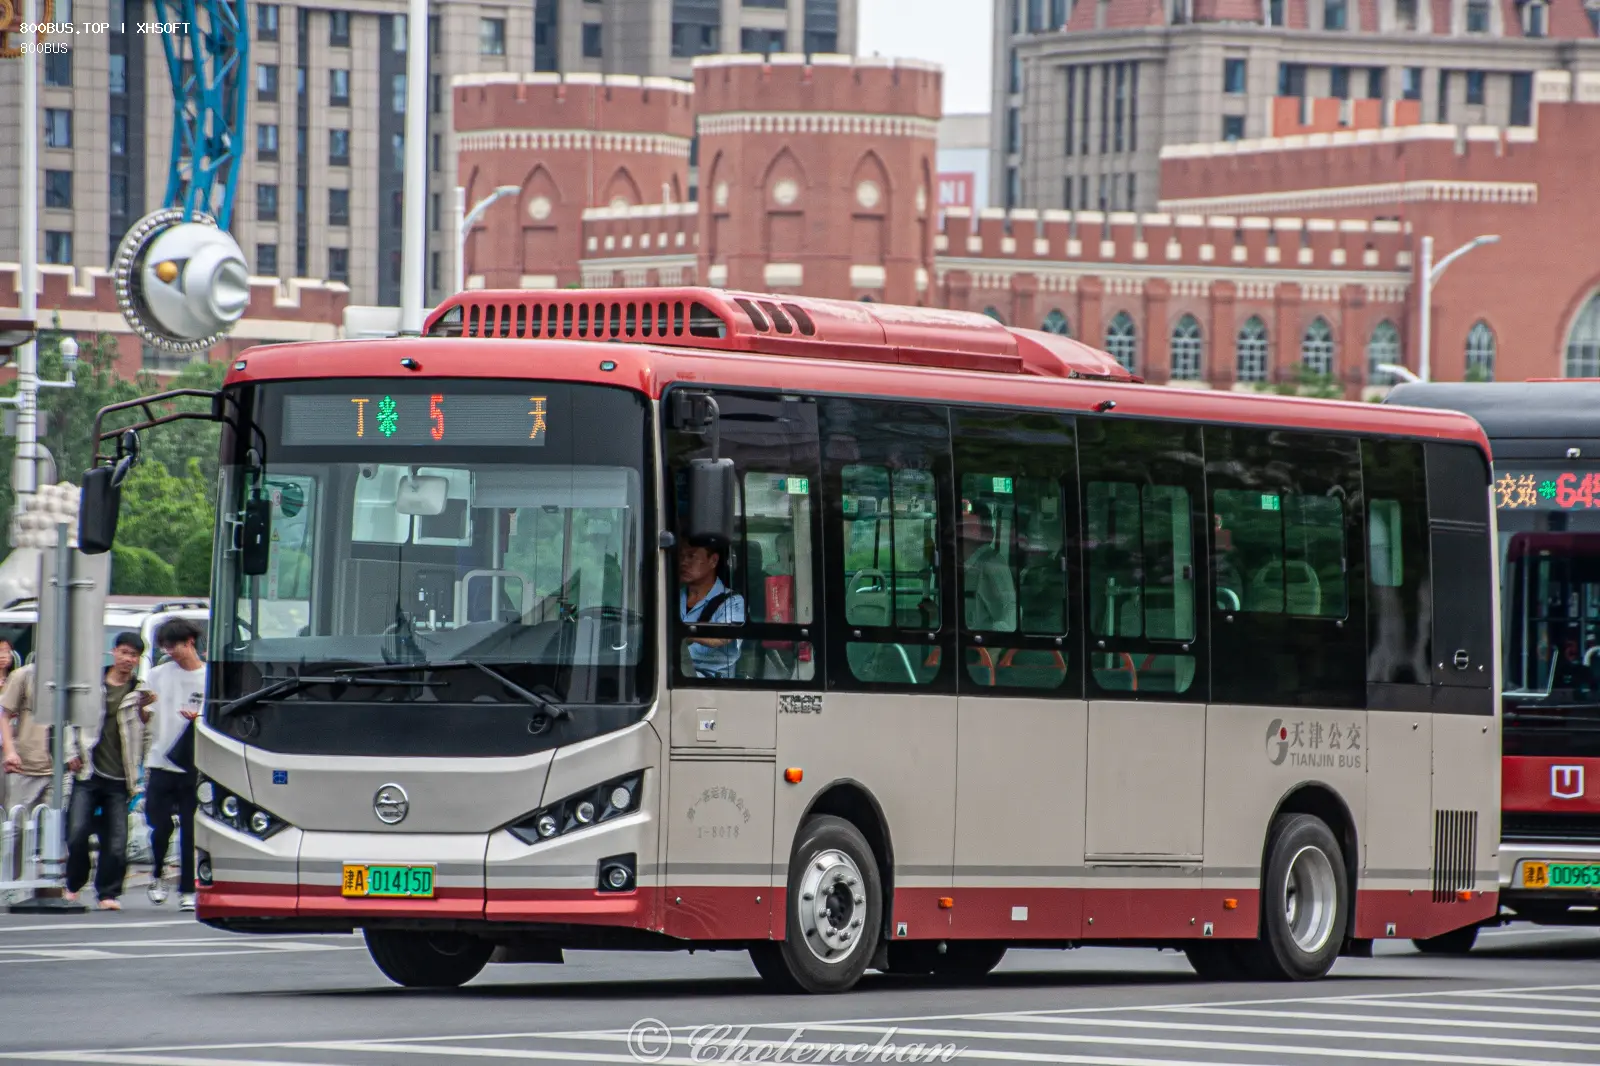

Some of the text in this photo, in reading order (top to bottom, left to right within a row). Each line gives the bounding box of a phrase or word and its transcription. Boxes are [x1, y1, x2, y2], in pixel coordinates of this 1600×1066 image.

[429, 393, 445, 441] 5
[1290, 721, 1362, 751] 天津公交
[1290, 752, 1362, 769] TIANJIN BUS
